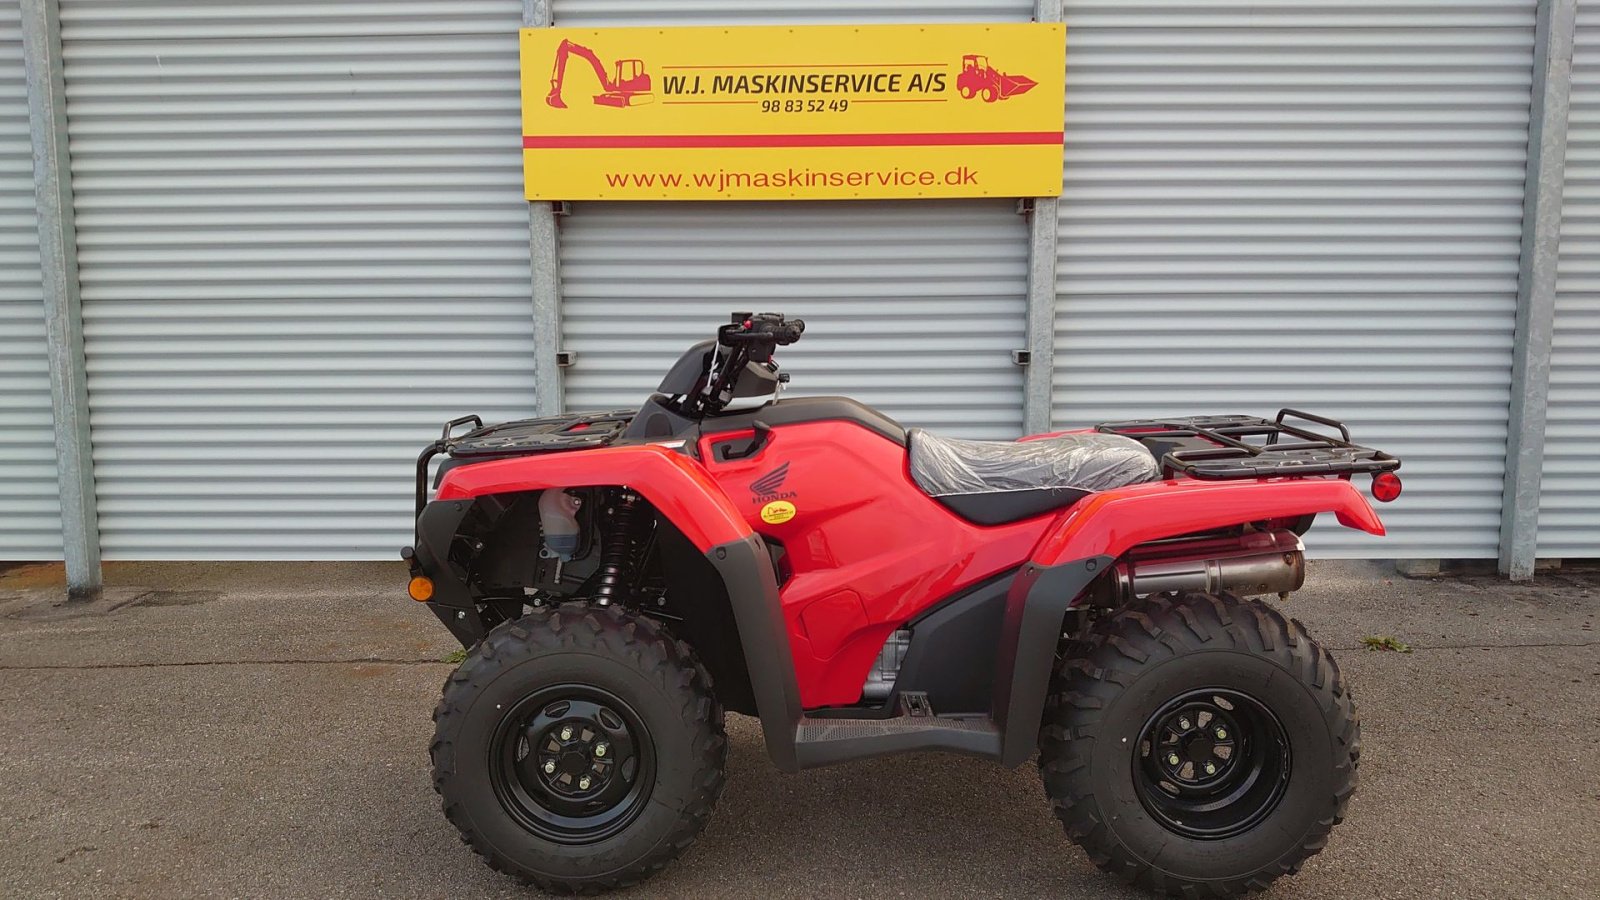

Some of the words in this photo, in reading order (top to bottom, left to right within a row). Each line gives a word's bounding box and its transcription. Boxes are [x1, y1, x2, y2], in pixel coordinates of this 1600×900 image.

[663, 75, 705, 95] W.J.
[712, 73, 902, 94] MASKINSERVICE
[907, 73, 947, 93] A/S
[762, 100, 781, 113] 98
[784, 100, 803, 113] 83
[807, 99, 825, 113] 52
[828, 99, 848, 112] 49
[605, 166, 978, 193] www.wjmaskinservice.dk
[752, 491, 797, 504] HONDA
